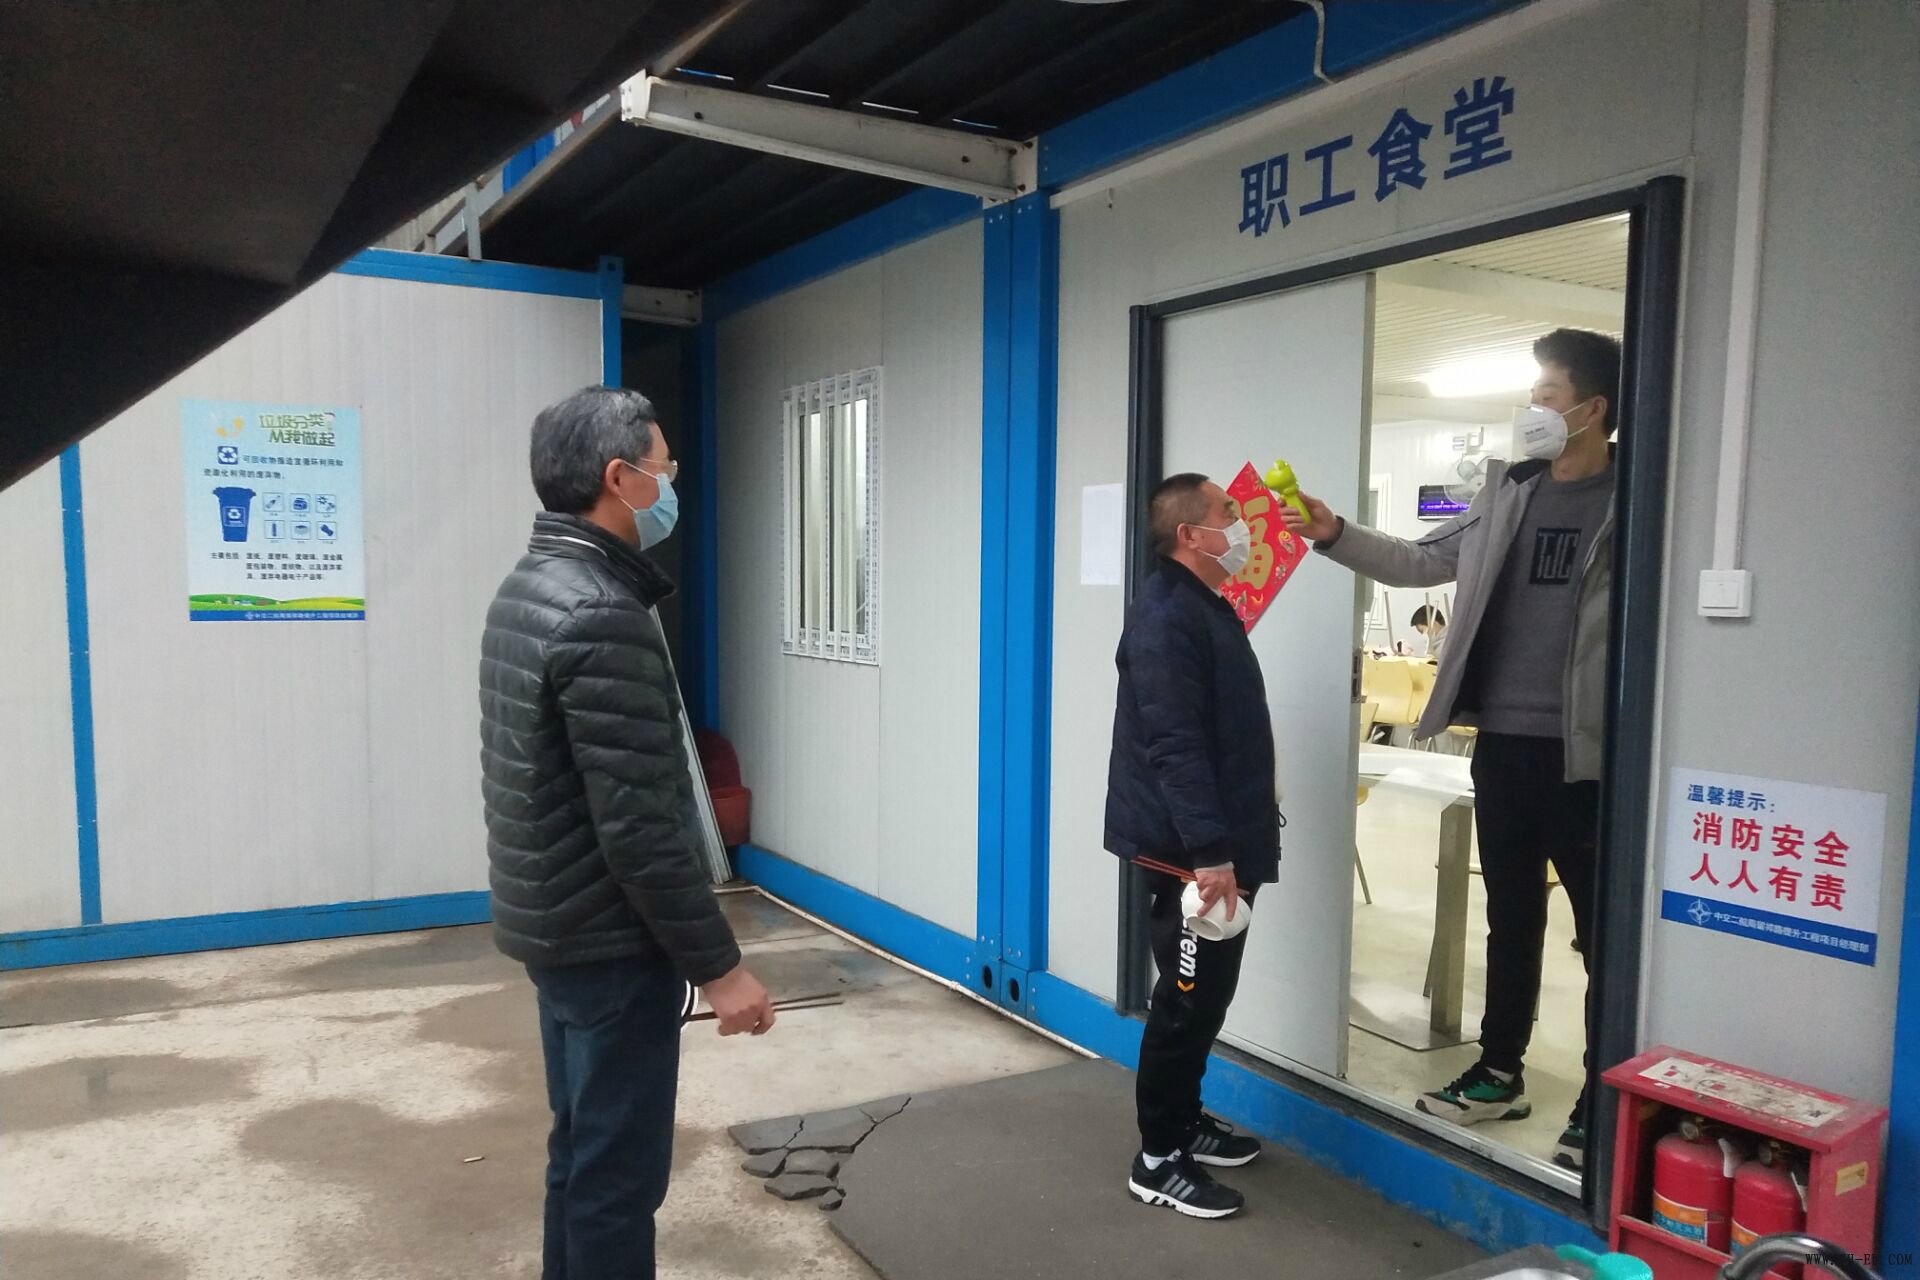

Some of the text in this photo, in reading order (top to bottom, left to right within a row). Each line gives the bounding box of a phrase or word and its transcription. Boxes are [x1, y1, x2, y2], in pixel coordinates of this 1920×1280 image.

[1239, 76, 1514, 237] 职工食堂
[259, 414, 325, 429] 垃圾分类
[269, 429, 336, 447] 从我做起
[1692, 812, 1849, 867] 消防安全
[1689, 853, 1846, 911] 人人有责
